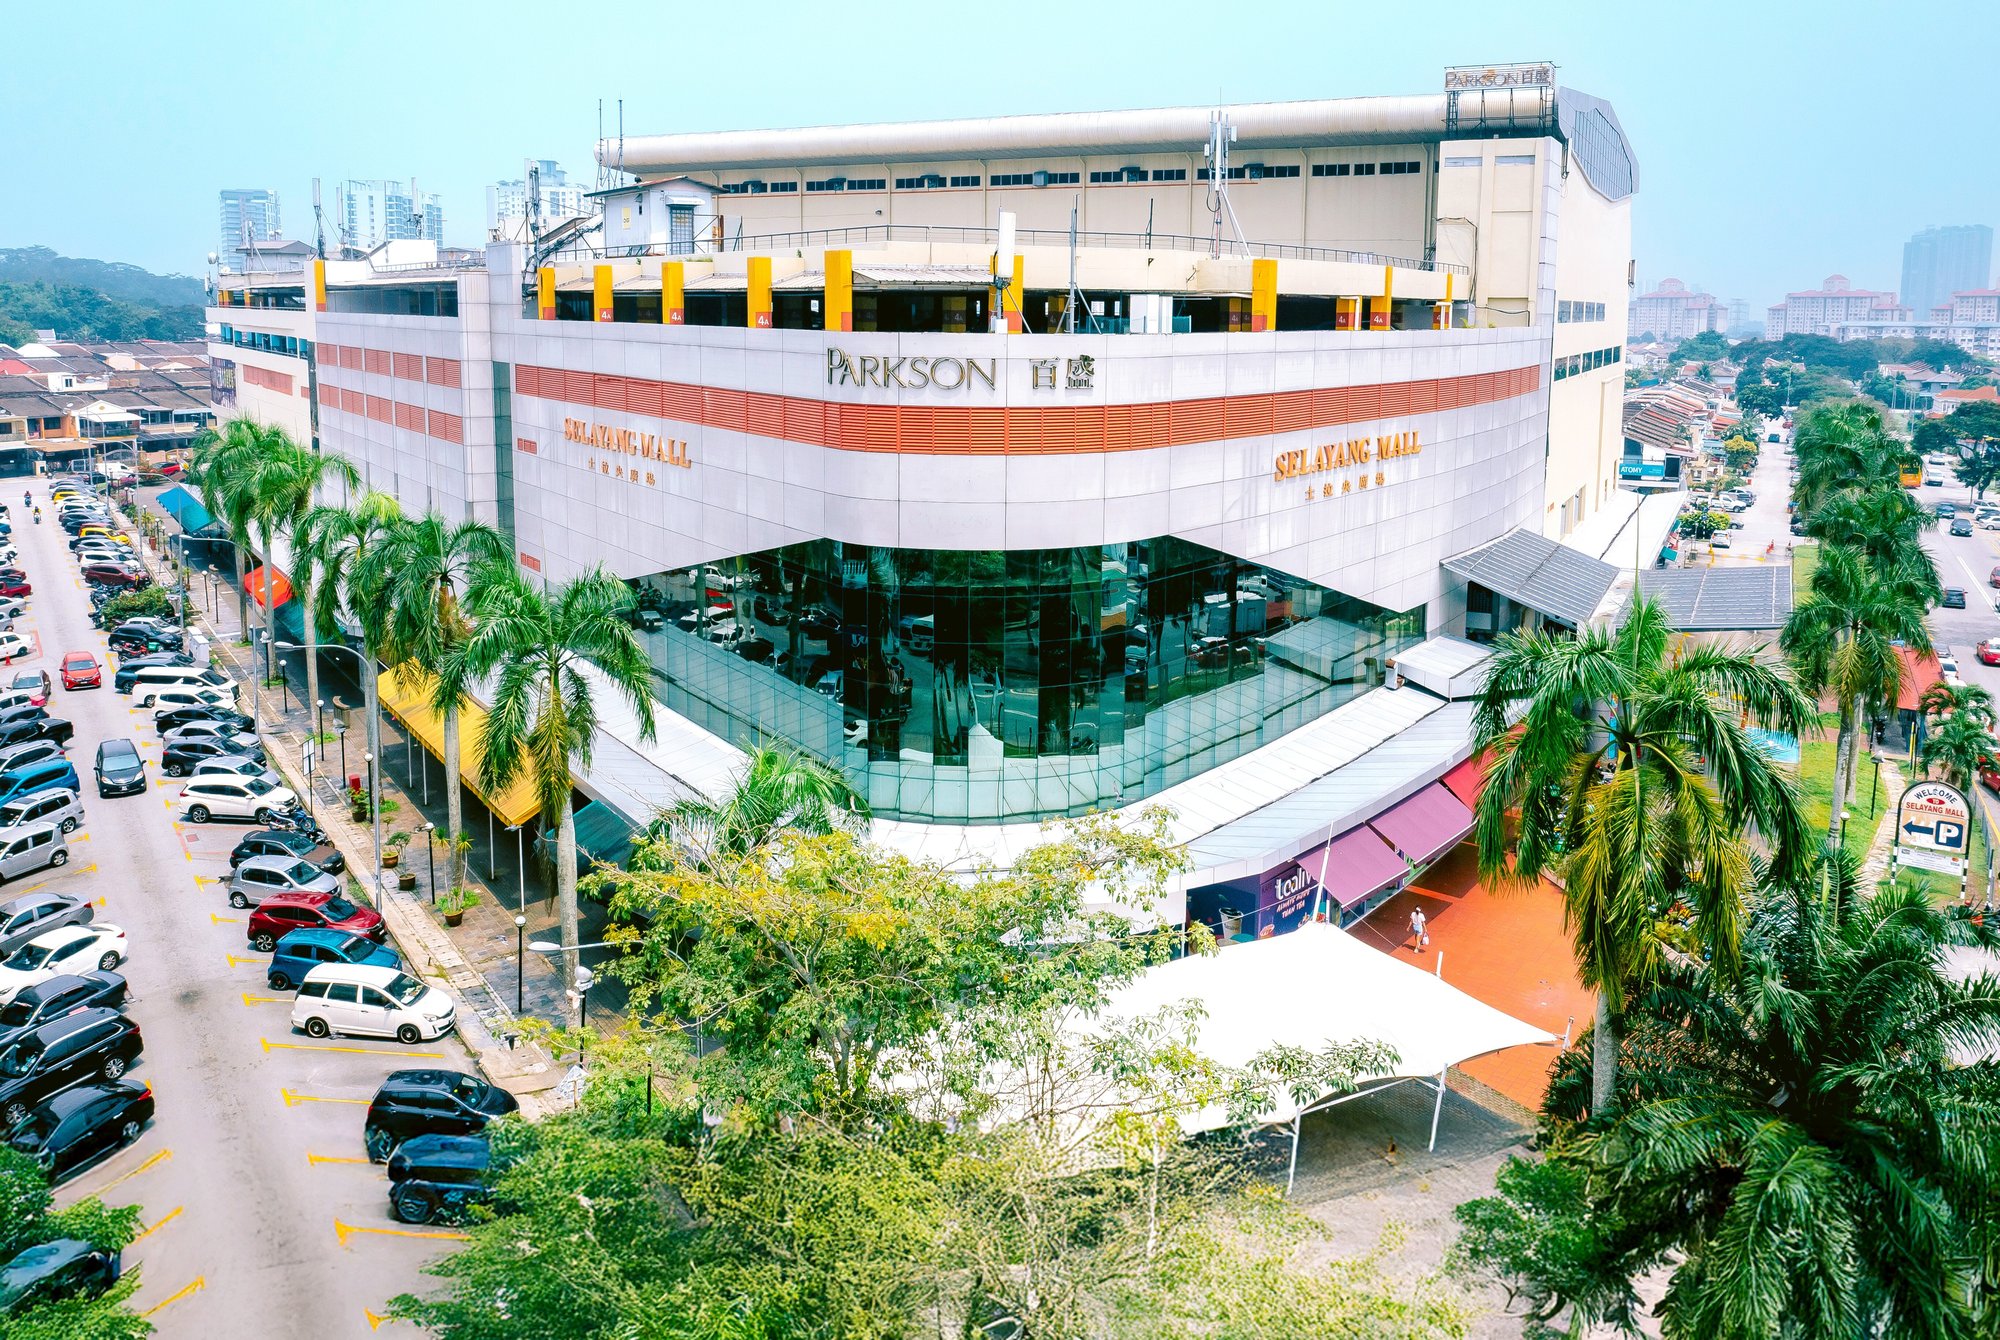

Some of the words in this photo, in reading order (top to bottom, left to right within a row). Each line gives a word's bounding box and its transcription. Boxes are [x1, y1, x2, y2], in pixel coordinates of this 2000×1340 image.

[1445, 71, 1518, 88] PARKSON
[1521, 65, 1550, 85] 百盛
[601, 310, 612, 320] 4A
[671, 311, 682, 321] 4A
[758, 315, 769, 326] 4A
[1373, 315, 1383, 324] 4A
[827, 347, 996, 391] PARKSON
[1029, 354, 1096, 389] 百盛
[564, 416, 637, 456] SELAYANG
[640, 432, 692, 469] MALL
[1274, 437, 1371, 482] SELAYANG
[1377, 431, 1422, 462] MALL
[1914, 788, 1958, 804] WELCOME
[1905, 801, 1943, 814] SELAYANG
[1945, 808, 1965, 818] MALL
[1938, 823, 1959, 844] P
